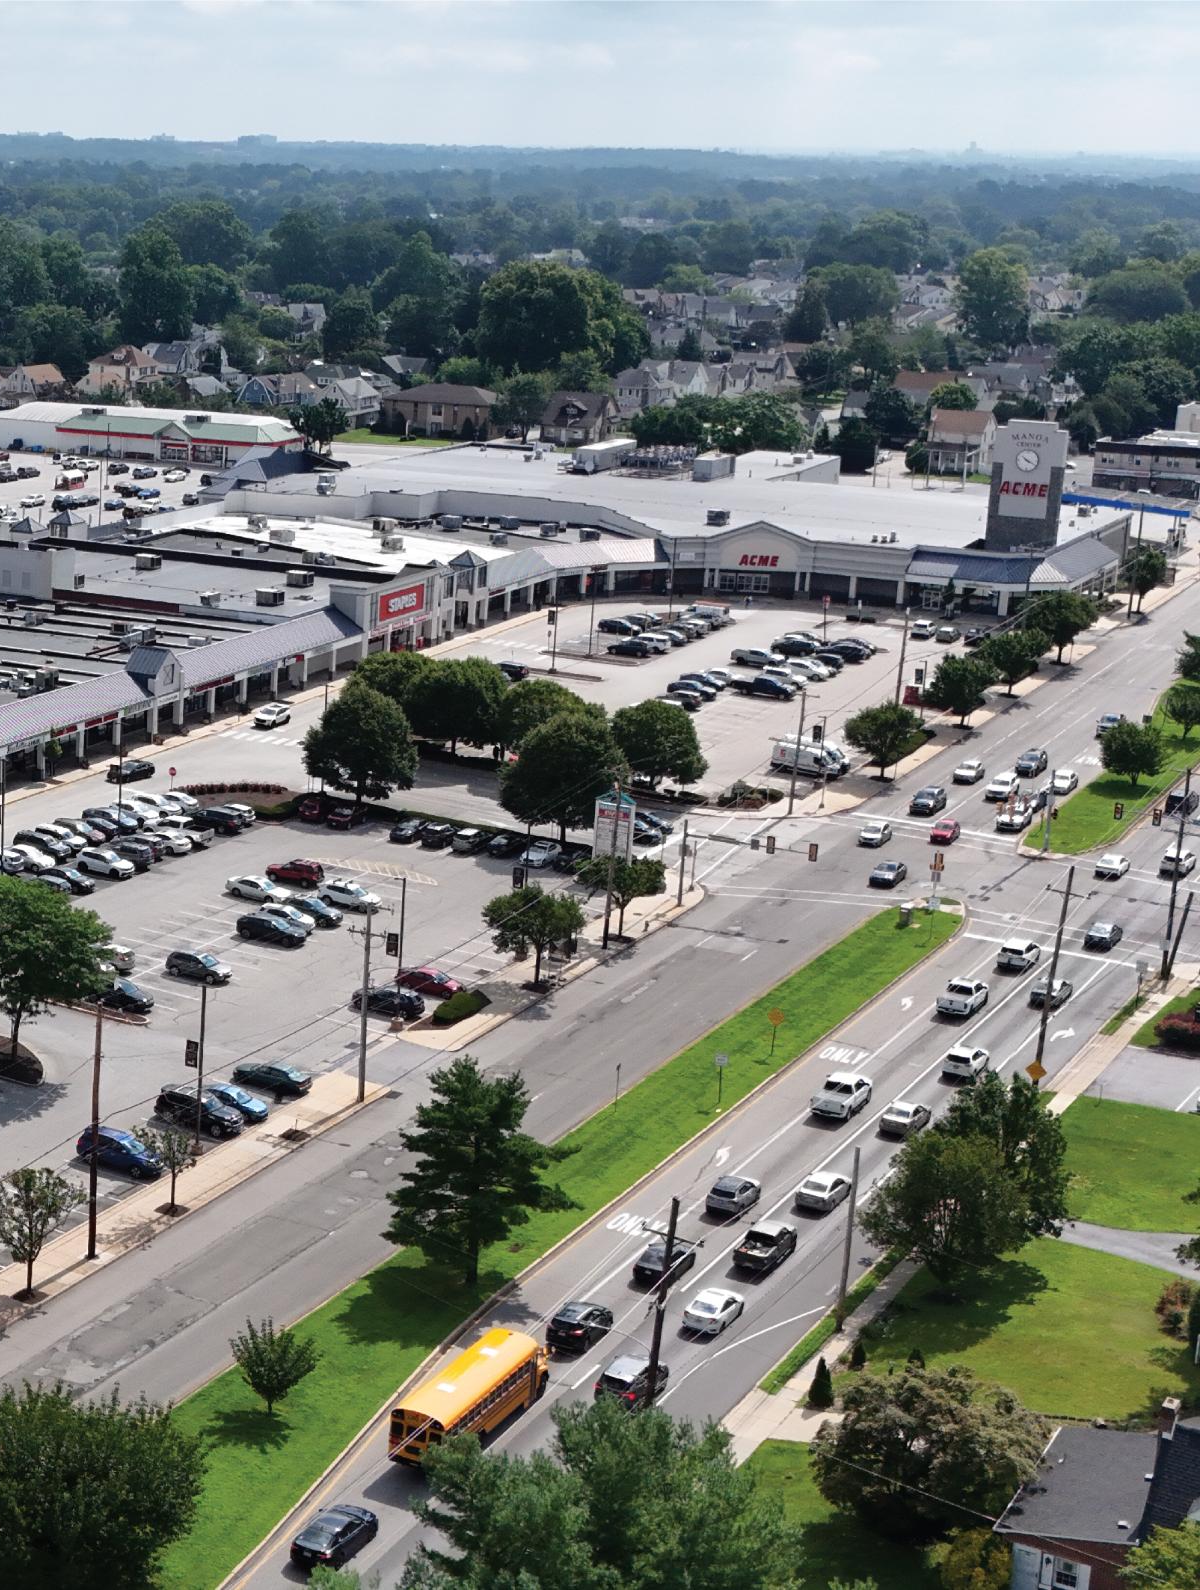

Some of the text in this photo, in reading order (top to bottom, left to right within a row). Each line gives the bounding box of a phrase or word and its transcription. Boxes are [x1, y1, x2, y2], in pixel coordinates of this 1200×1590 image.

[1000, 480, 1049, 497] ACME
[738, 554, 779, 567] ACME
[819, 1046, 869, 1065] ONLY
[606, 1213, 667, 1238] ONLY
